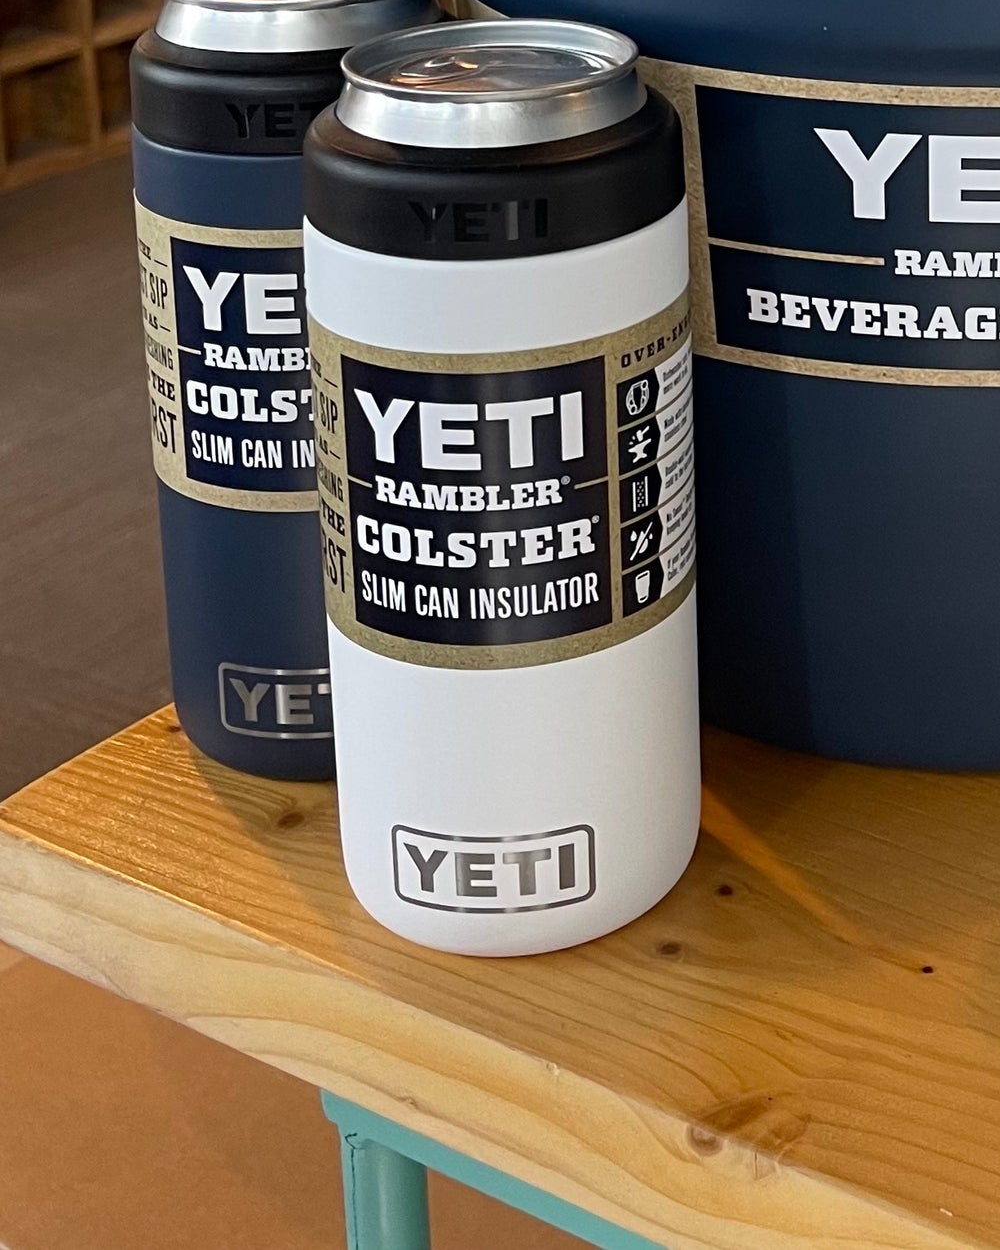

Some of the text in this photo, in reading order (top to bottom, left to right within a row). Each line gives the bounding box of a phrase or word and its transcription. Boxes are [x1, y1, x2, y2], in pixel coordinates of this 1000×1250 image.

[407, 199, 549, 243] YETI
[150, 275, 168, 311] SIP
[182, 265, 302, 335] YE
[151, 376, 176, 402] THE
[320, 393, 338, 435] SIP
[353, 388, 585, 471] YETI
[191, 430, 234, 466] SLIM
[241, 438, 283, 469] CAN
[321, 498, 345, 537] THE
[361, 570, 600, 620] SLIM CAN INSULATOR
[403, 843, 575, 898] YETI
